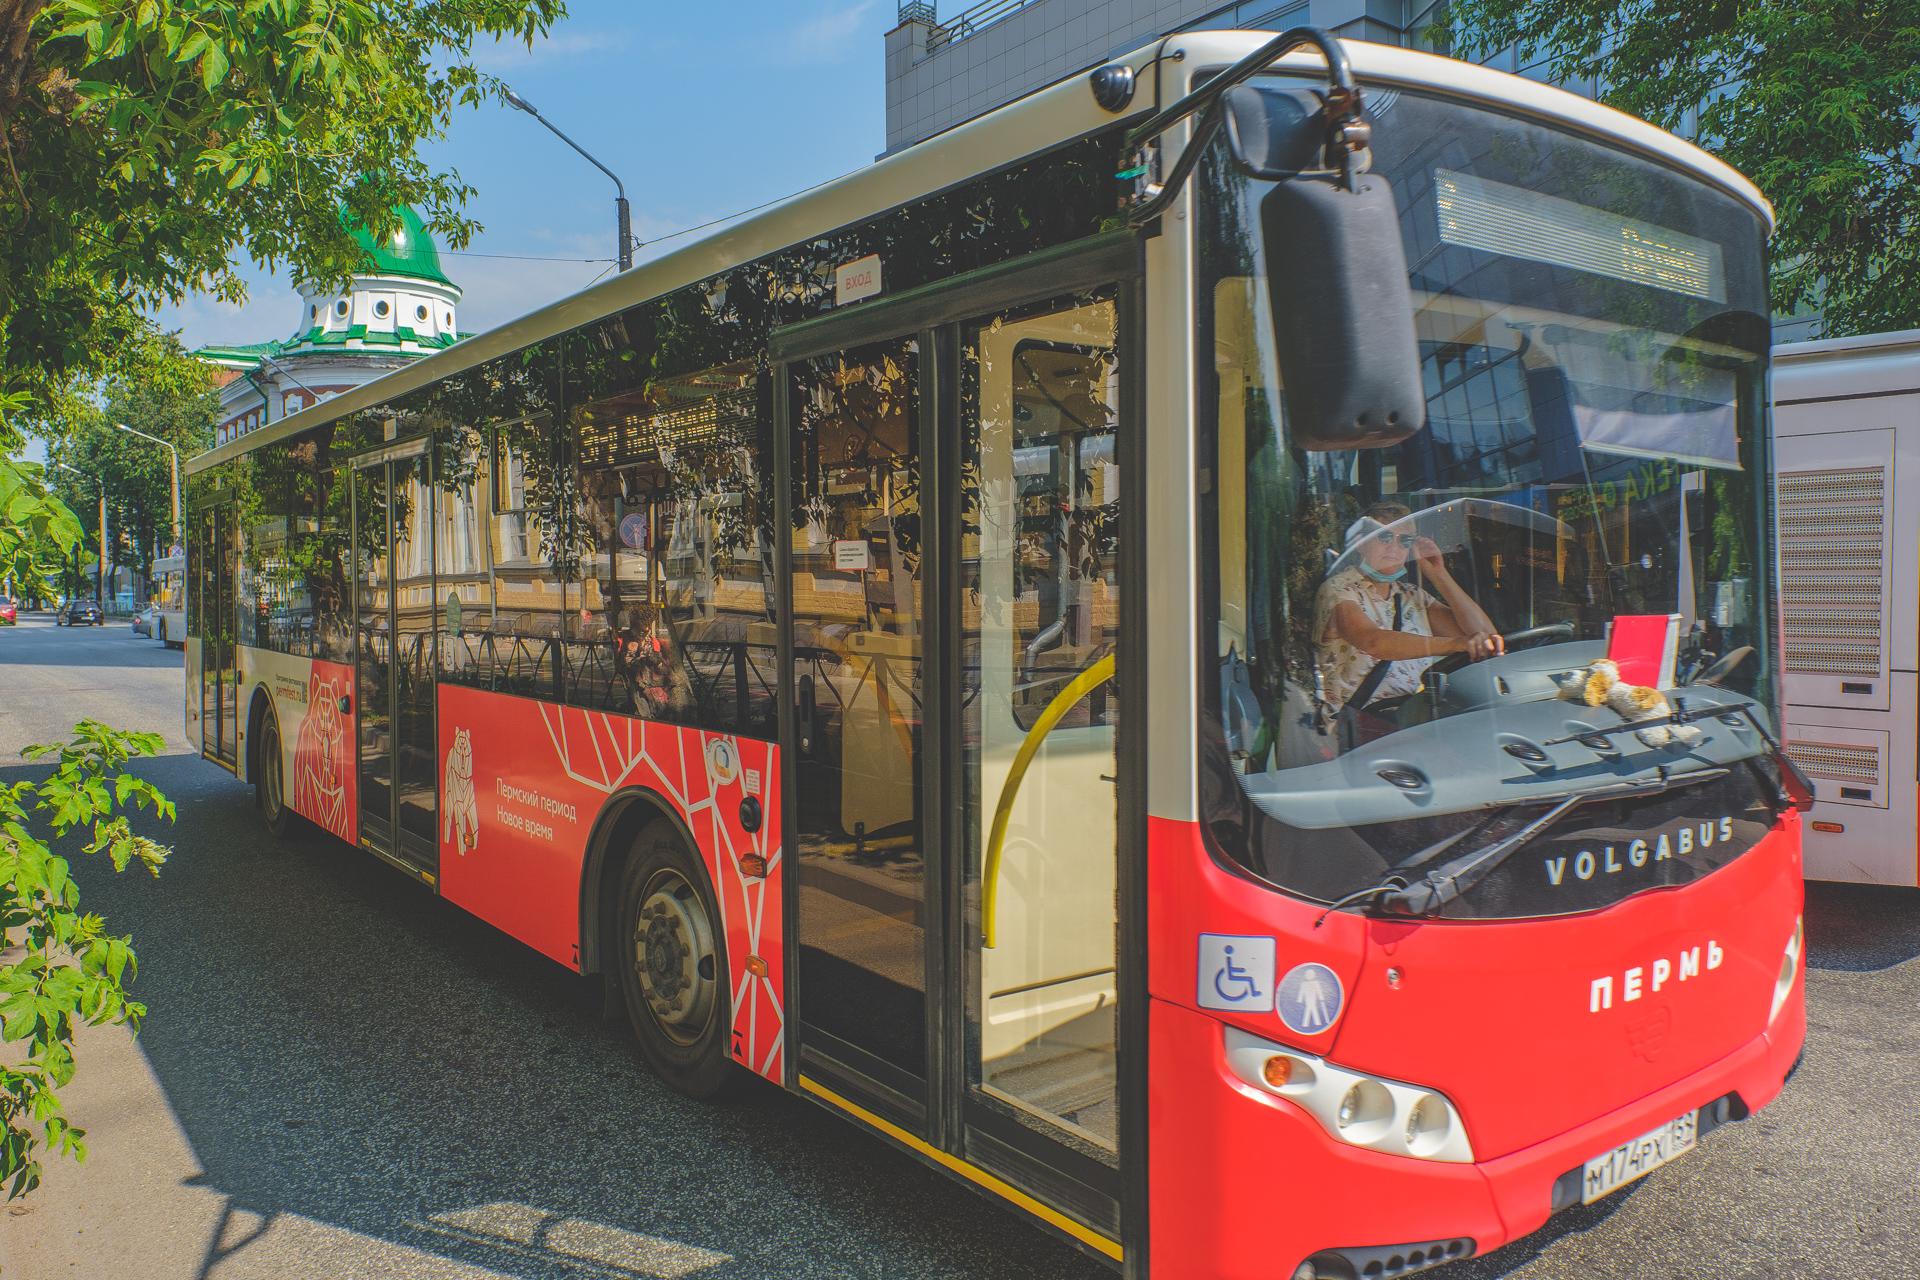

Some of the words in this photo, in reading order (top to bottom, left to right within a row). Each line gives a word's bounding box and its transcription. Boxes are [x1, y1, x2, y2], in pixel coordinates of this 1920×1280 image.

[845, 271, 872, 290] ВХОД
[496, 777, 539, 809] Пермский
[540, 796, 577, 824] период
[496, 804, 523, 830] Новое
[525, 818, 553, 841] время
[1545, 816, 1733, 886] VOLGABUS
[1589, 939, 1725, 1013] ПЕРМЬ
